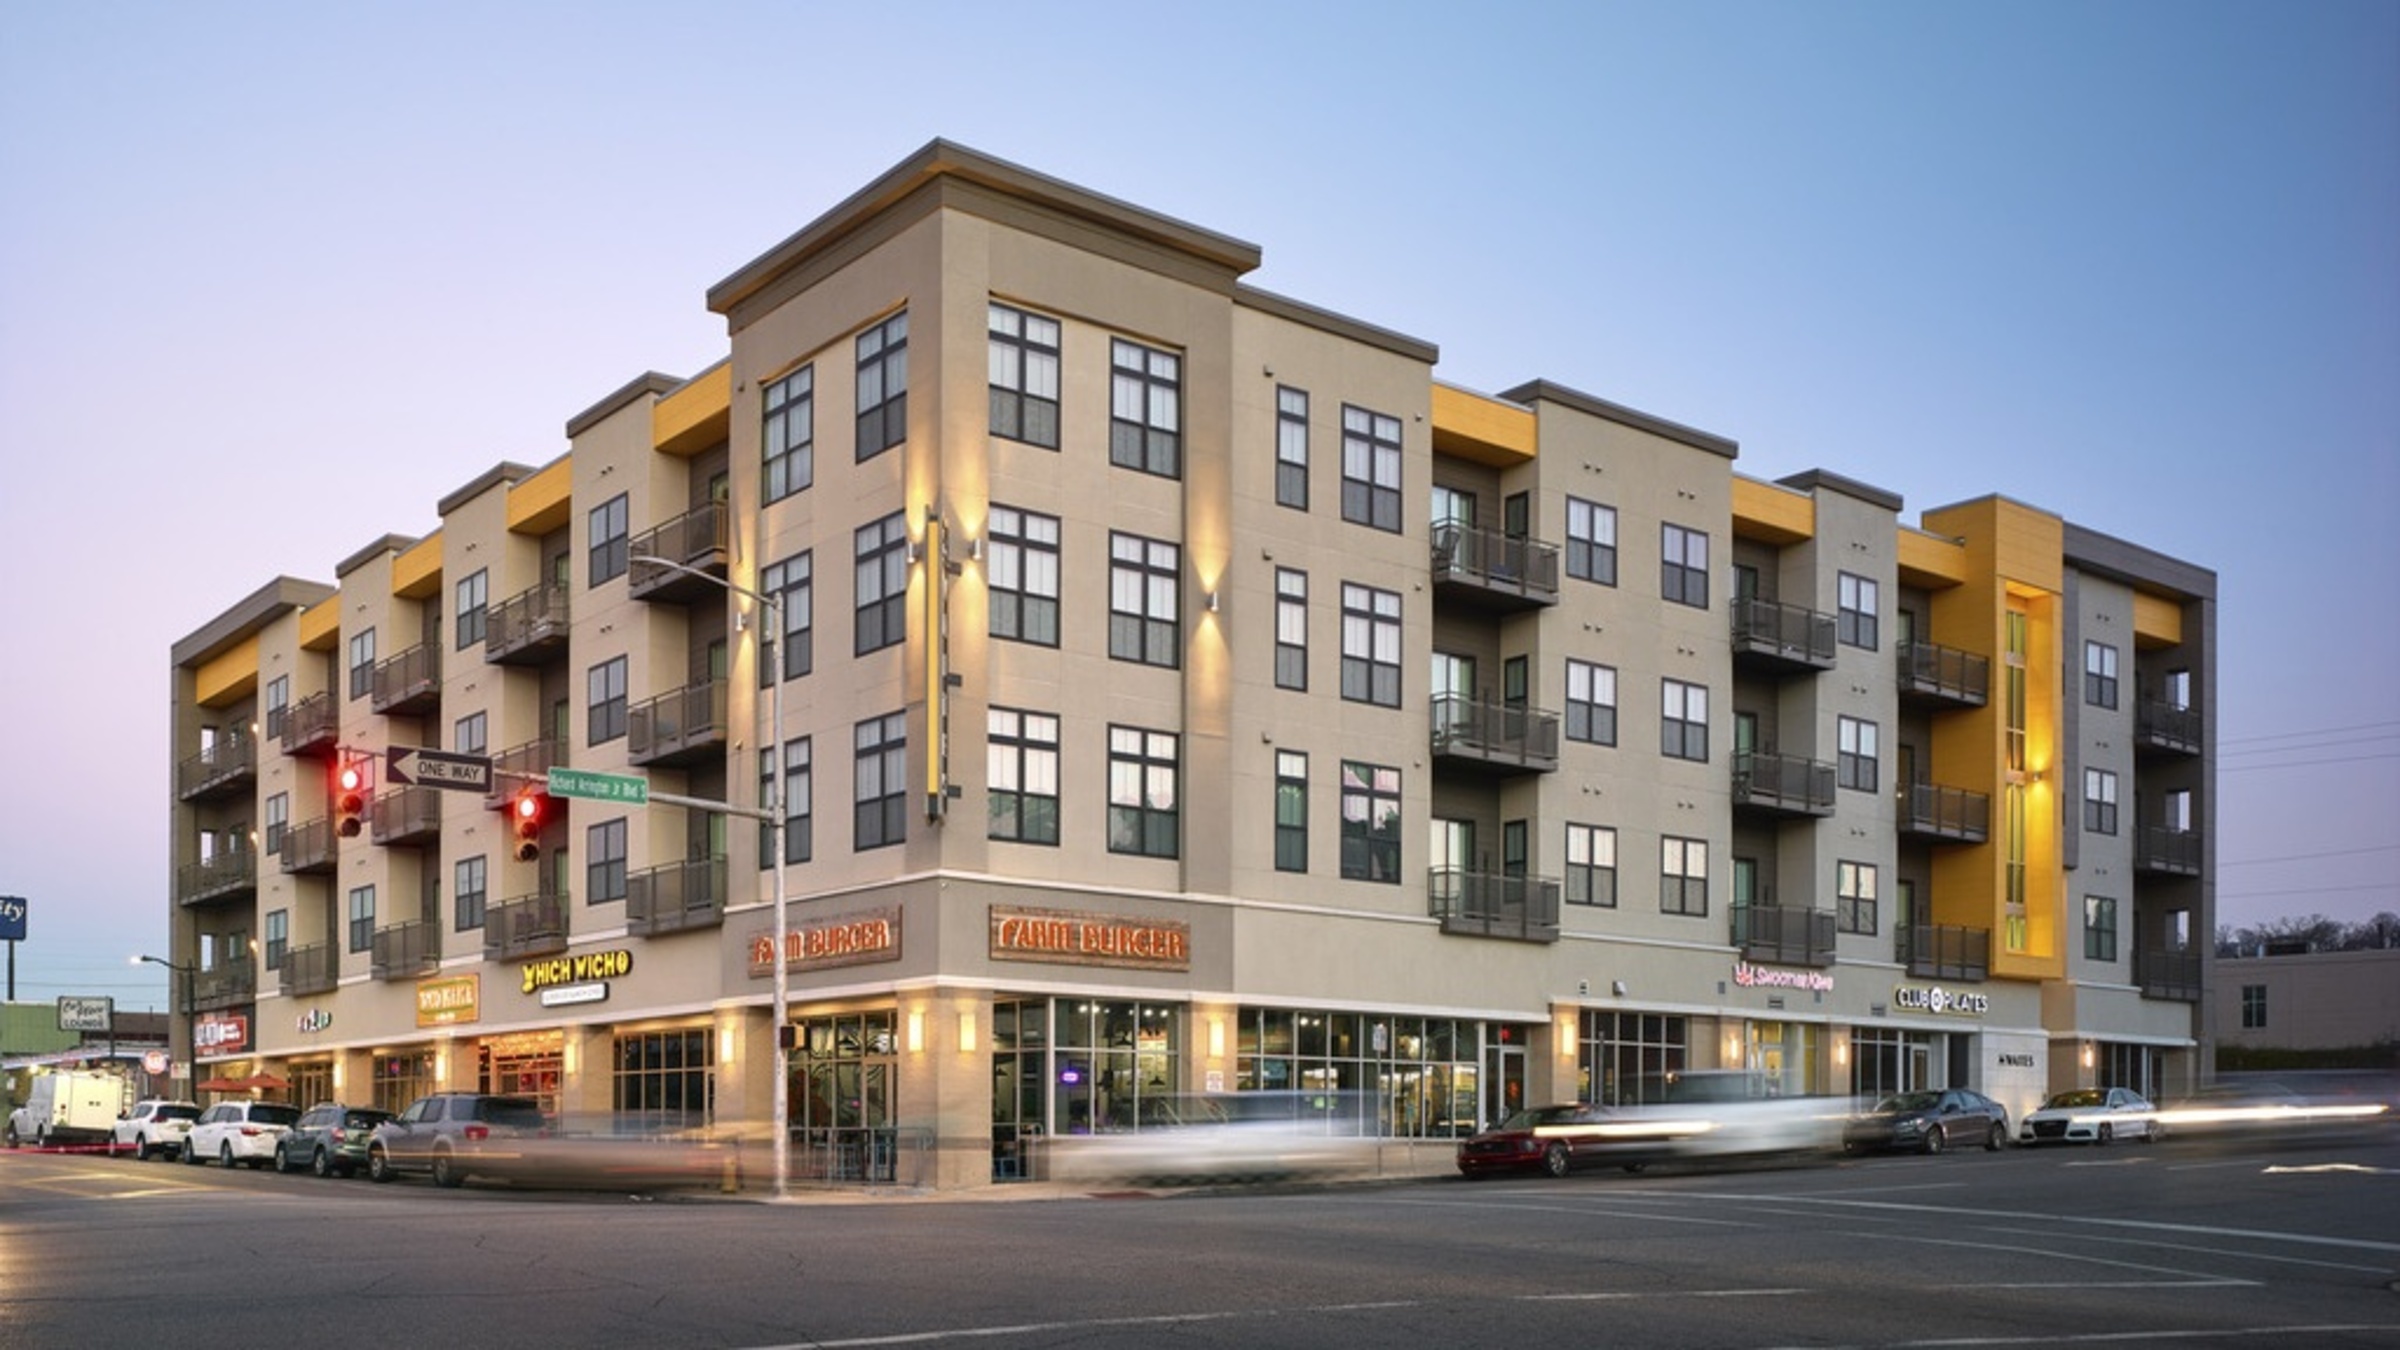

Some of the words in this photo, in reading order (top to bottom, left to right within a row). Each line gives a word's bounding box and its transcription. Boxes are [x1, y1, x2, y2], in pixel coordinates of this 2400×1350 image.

[418, 761, 445, 776] ONE
[452, 764, 481, 780] WAY
[754, 931, 805, 963] FAM
[808, 918, 890, 958] BURGER
[1000, 916, 1073, 949] FARM
[1080, 922, 1185, 958] BURGER
[522, 958, 572, 993] WHICH
[1898, 988, 1930, 1008] CLUB
[1944, 991, 1989, 1013] PILATES
